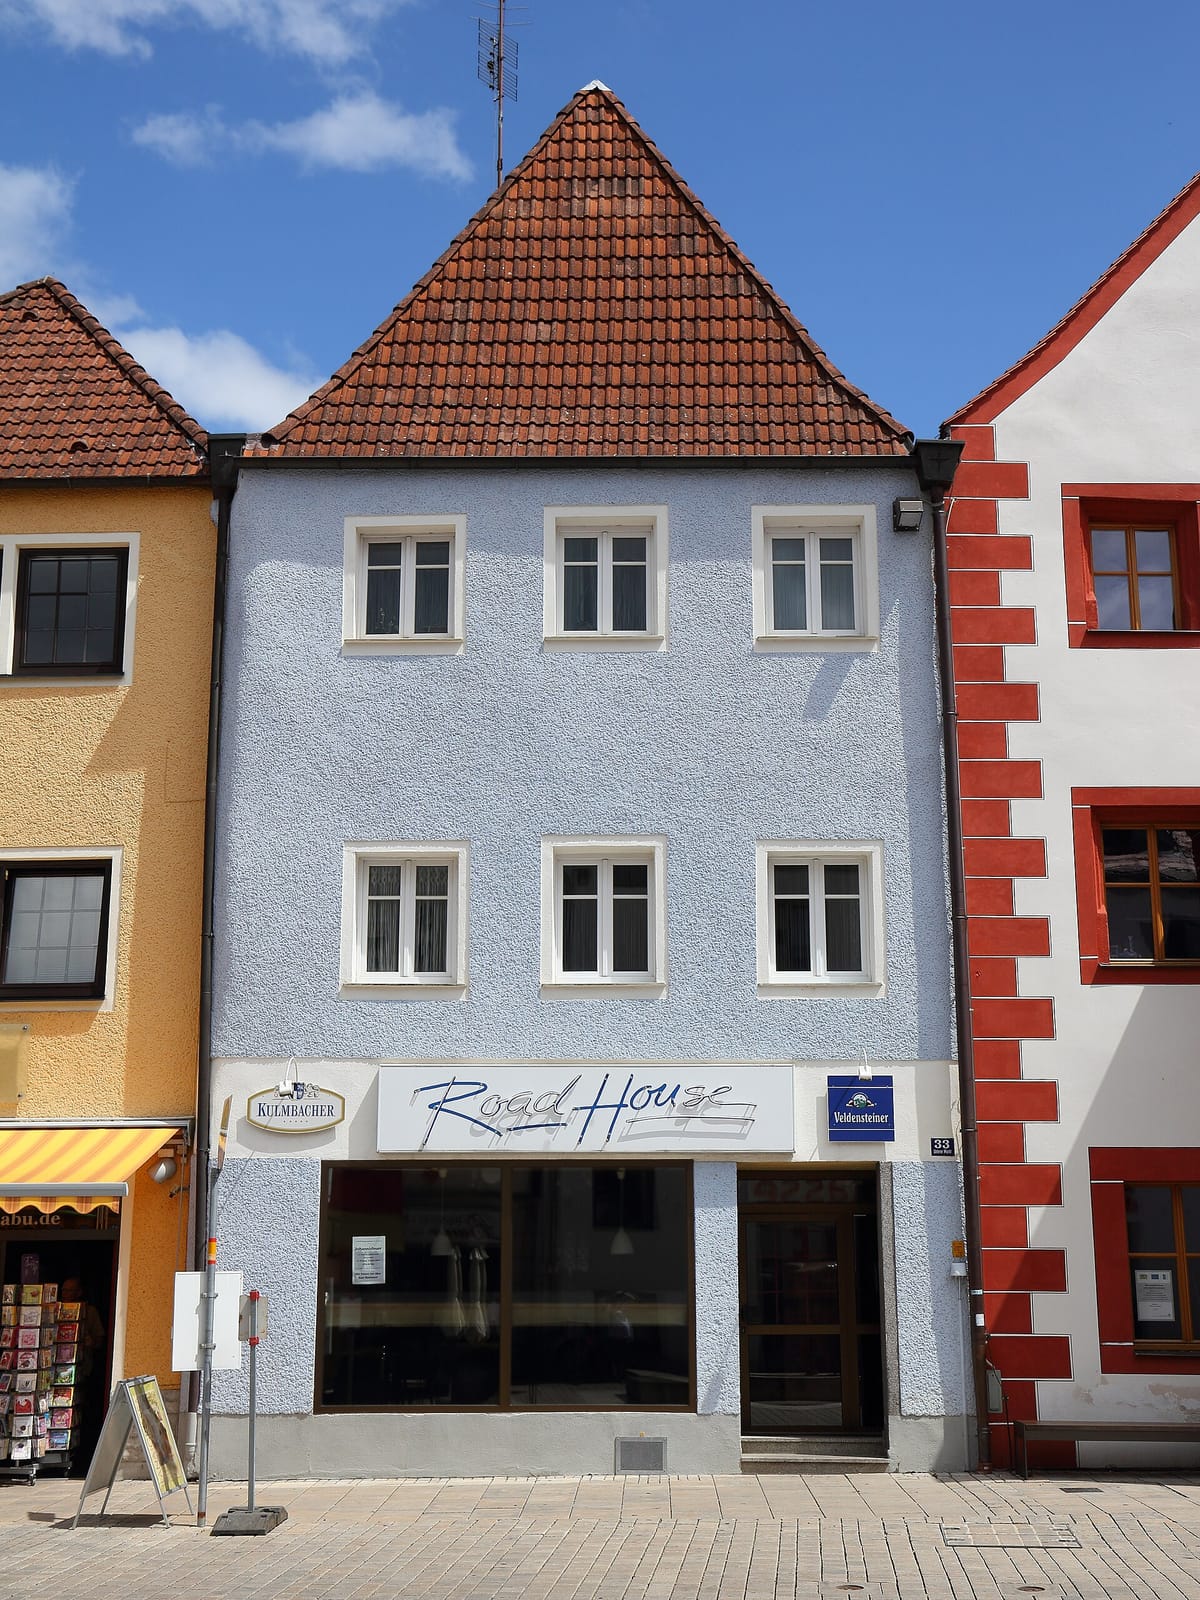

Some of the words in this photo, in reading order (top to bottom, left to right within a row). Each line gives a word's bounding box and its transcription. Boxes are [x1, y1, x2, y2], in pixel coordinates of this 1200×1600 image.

[257, 1102, 336, 1117] KULMBACHER
[413, 1074, 583, 1147] Road
[572, 1073, 757, 1145] House
[833, 1111, 889, 1124] Veldensteiner
[934, 1139, 950, 1149] 33
